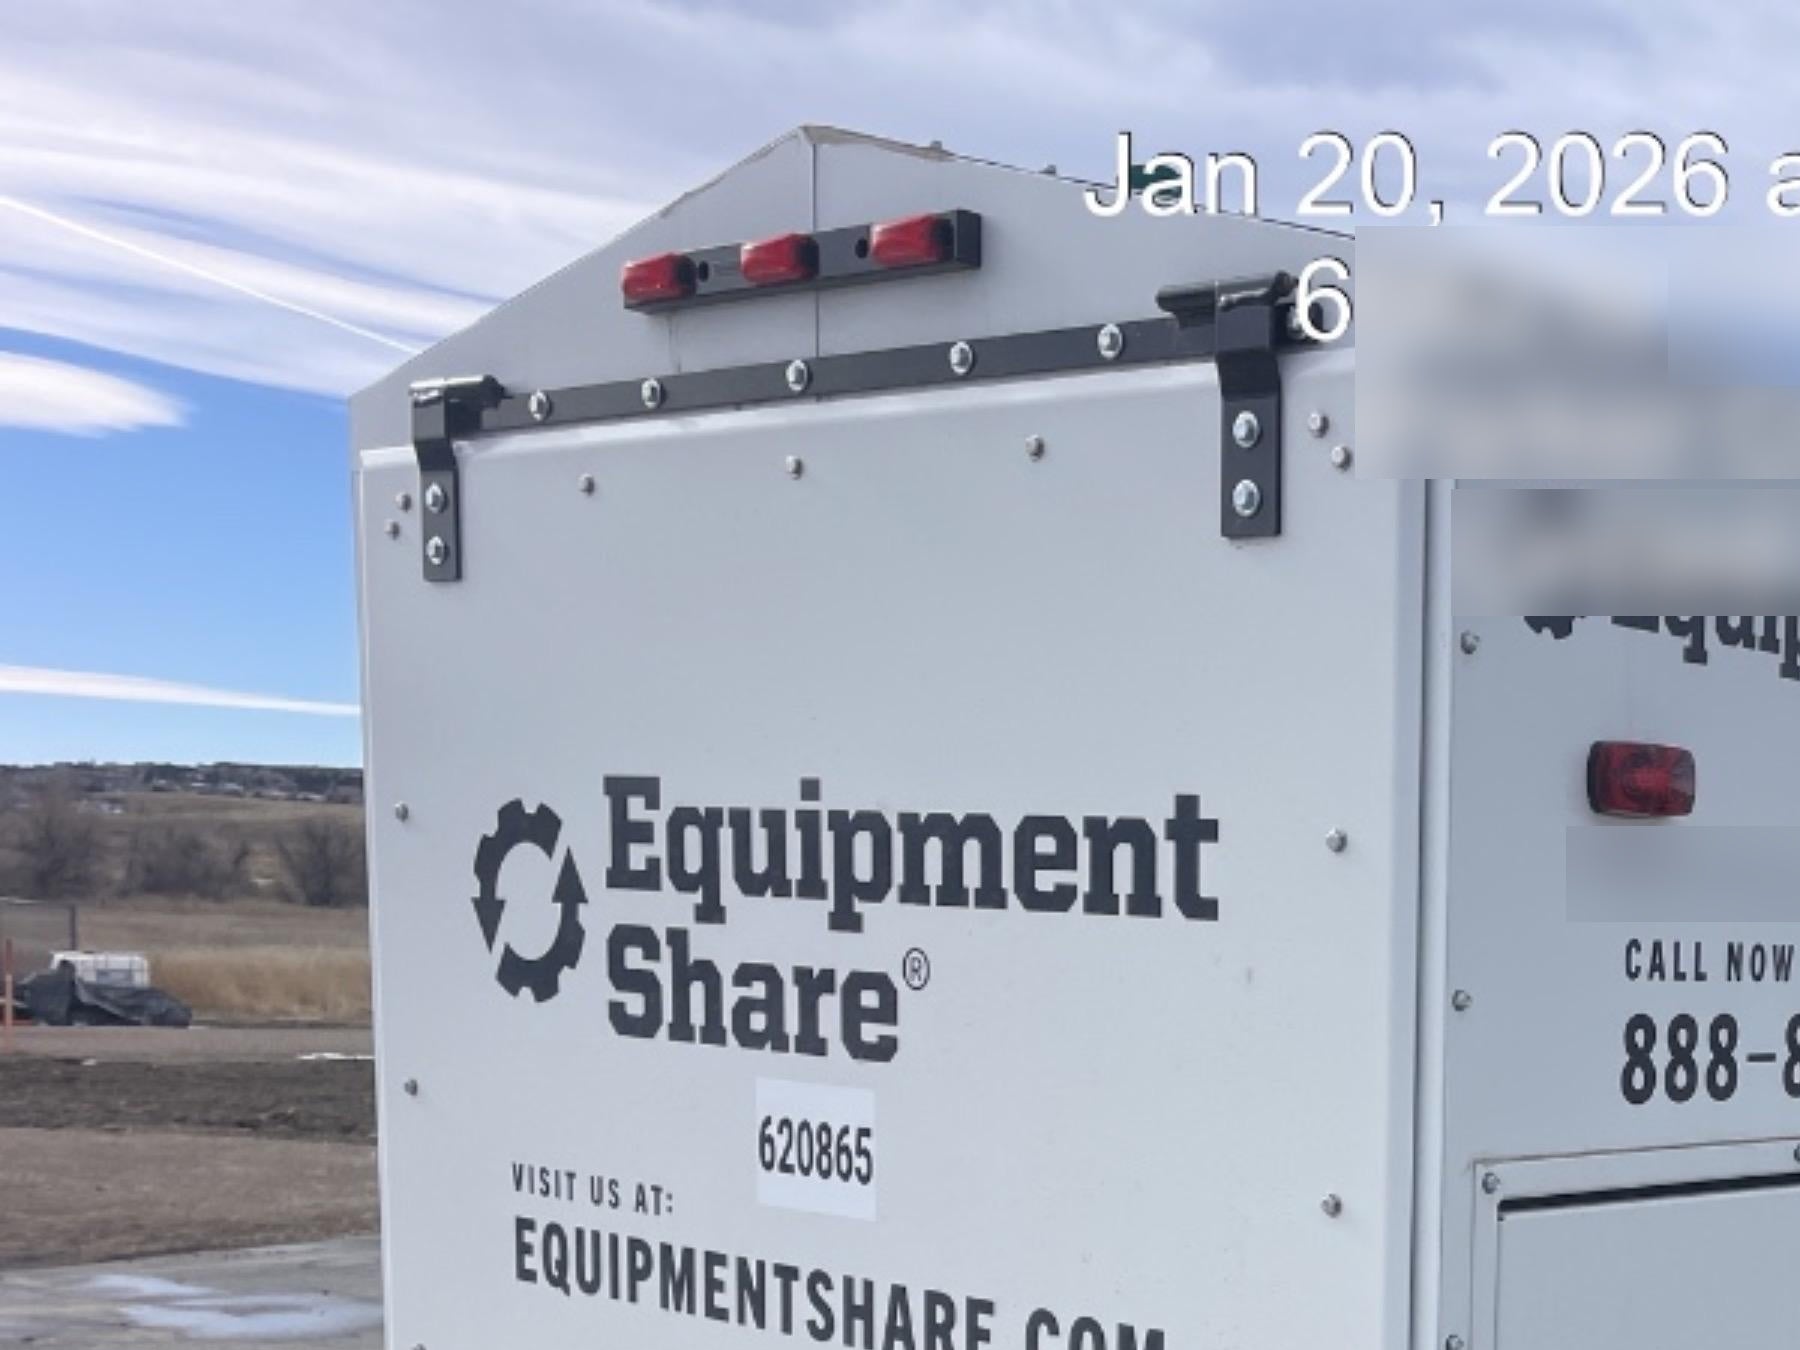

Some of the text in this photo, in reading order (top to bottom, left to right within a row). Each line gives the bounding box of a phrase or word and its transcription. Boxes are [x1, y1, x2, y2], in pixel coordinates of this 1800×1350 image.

[603, 775, 1219, 933] Equipment
[1624, 938, 1796, 983] CALL NOW
[758, 1114, 874, 1186] 620865
[512, 1161, 674, 1216] VISIT US AT:
